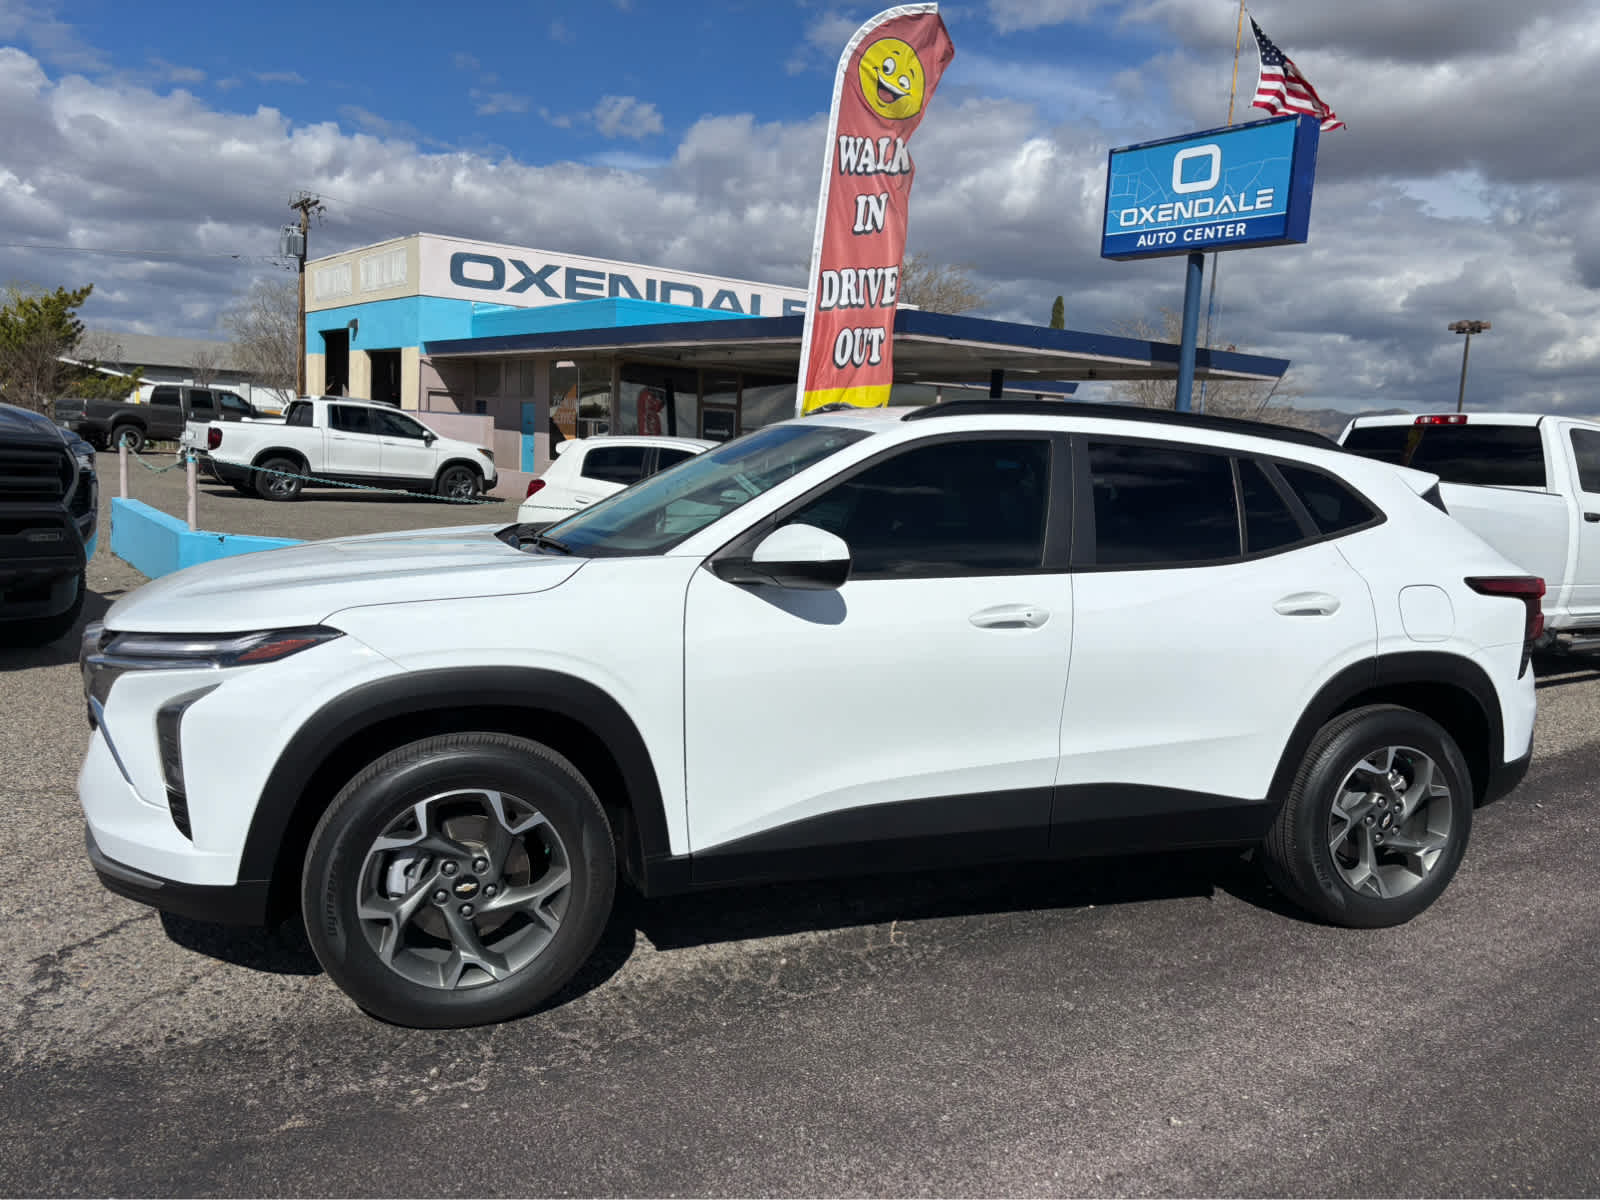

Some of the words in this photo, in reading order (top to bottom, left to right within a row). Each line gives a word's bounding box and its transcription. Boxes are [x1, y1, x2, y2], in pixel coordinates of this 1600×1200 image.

[838, 134, 912, 175] WALK
[853, 191, 889, 234] IN
[1120, 188, 1274, 227] OXENDALE
[1137, 231, 1177, 247] AUTO
[1183, 222, 1247, 242] CENTER
[819, 265, 899, 311] DRIVE
[833, 326, 886, 369] OUT
